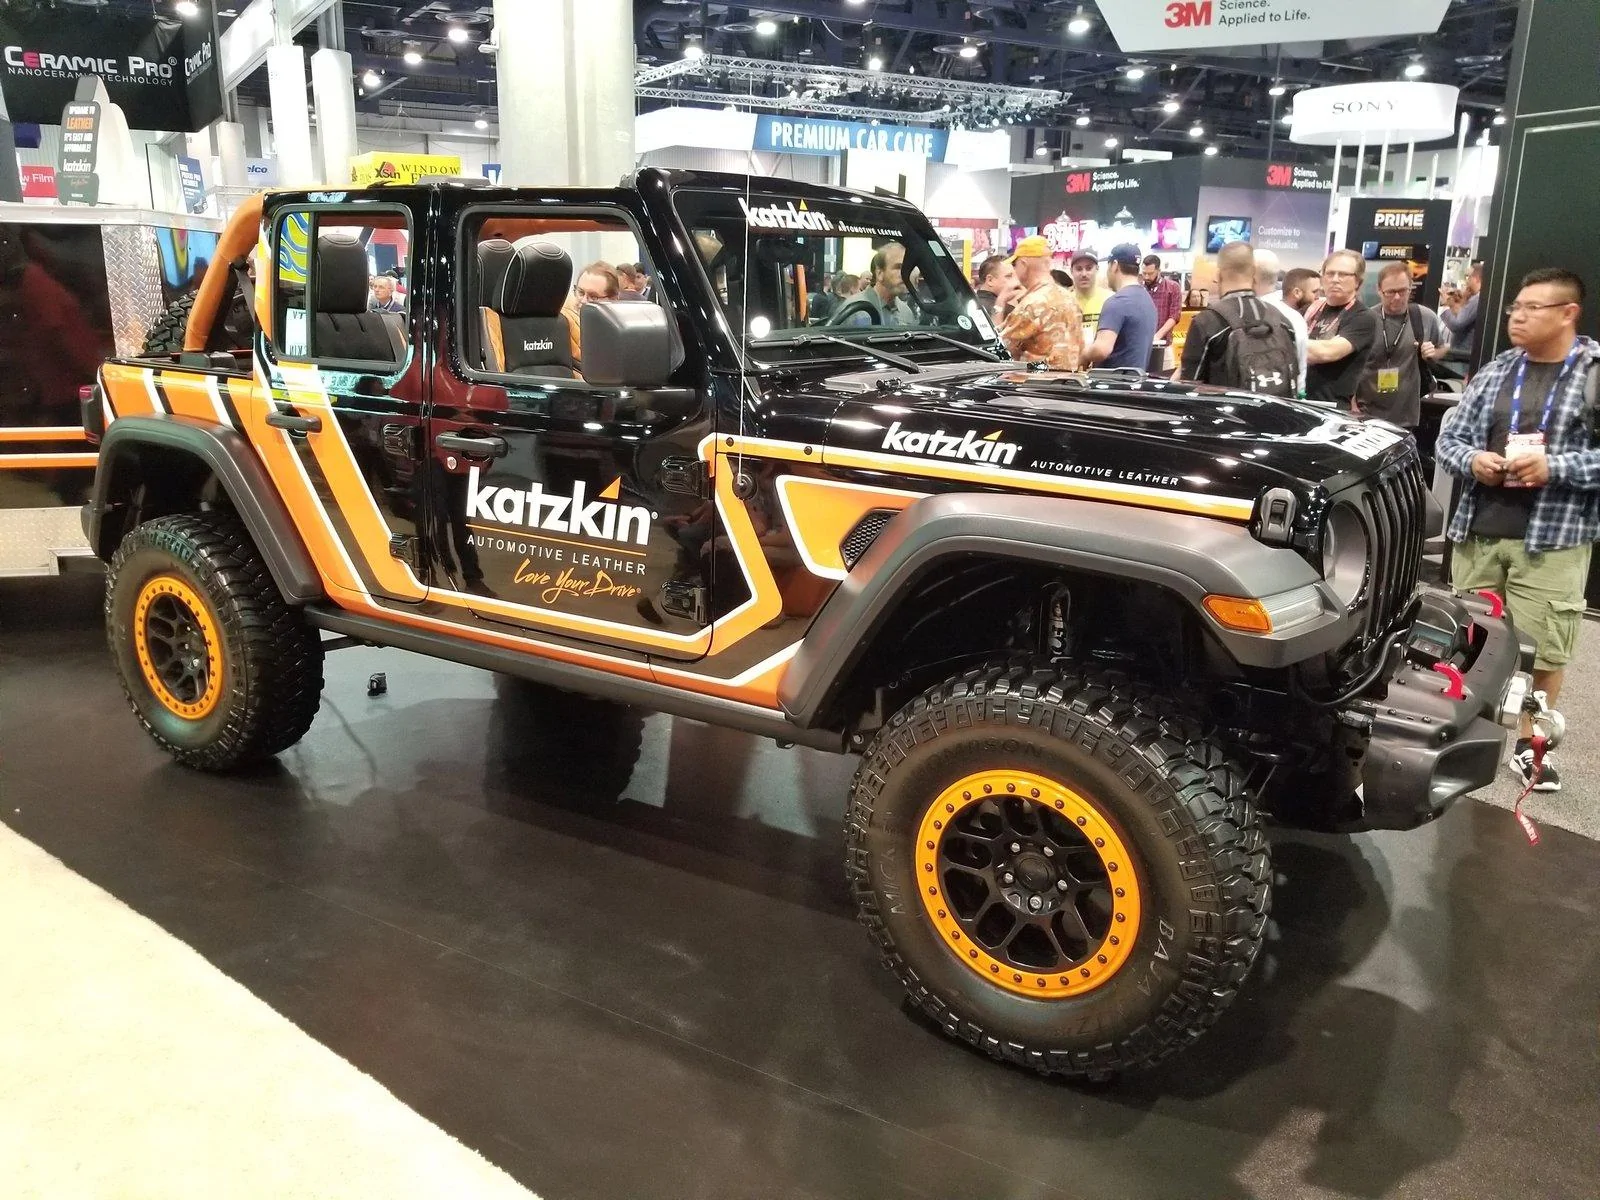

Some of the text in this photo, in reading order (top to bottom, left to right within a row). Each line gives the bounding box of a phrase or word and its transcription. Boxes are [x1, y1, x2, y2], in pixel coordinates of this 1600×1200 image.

[1219, 0, 1270, 10] Science.
[1164, 1, 1212, 28] 3M
[1218, 10, 1310, 26] Applied to Life.
[4, 45, 118, 73] CERAMIC
[102, 75, 173, 87] TECHNOLOGY
[1332, 100, 1397, 115] SONY
[771, 121, 933, 157] PREMIUM CAR CARE
[401, 163, 459, 175] WINDOW
[1093, 171, 1119, 180] Science.
[1267, 165, 1292, 186] 3M
[32, 173, 54, 183] Film
[1066, 172, 1091, 193] 3M
[1092, 178, 1139, 192] Applied to Life.
[1292, 178, 1316, 189] Applied
[1316, 180, 1322, 189] to
[738, 198, 831, 231] katzkin
[1374, 212, 1424, 227] PRIME
[1258, 225, 1300, 236] Customize to
[1380, 248, 1406, 256] PRIME
[523, 337, 553, 351] katzkin
[881, 421, 1179, 486] katzkin AUTOMOTIVE LEATHER
[466, 466, 651, 546] katzkin
[467, 534, 647, 576] AUTOMOTIVE LEATHER
[513, 558, 550, 585] Love
[541, 567, 592, 604] Your
[1136, 916, 1176, 997] BAJA
